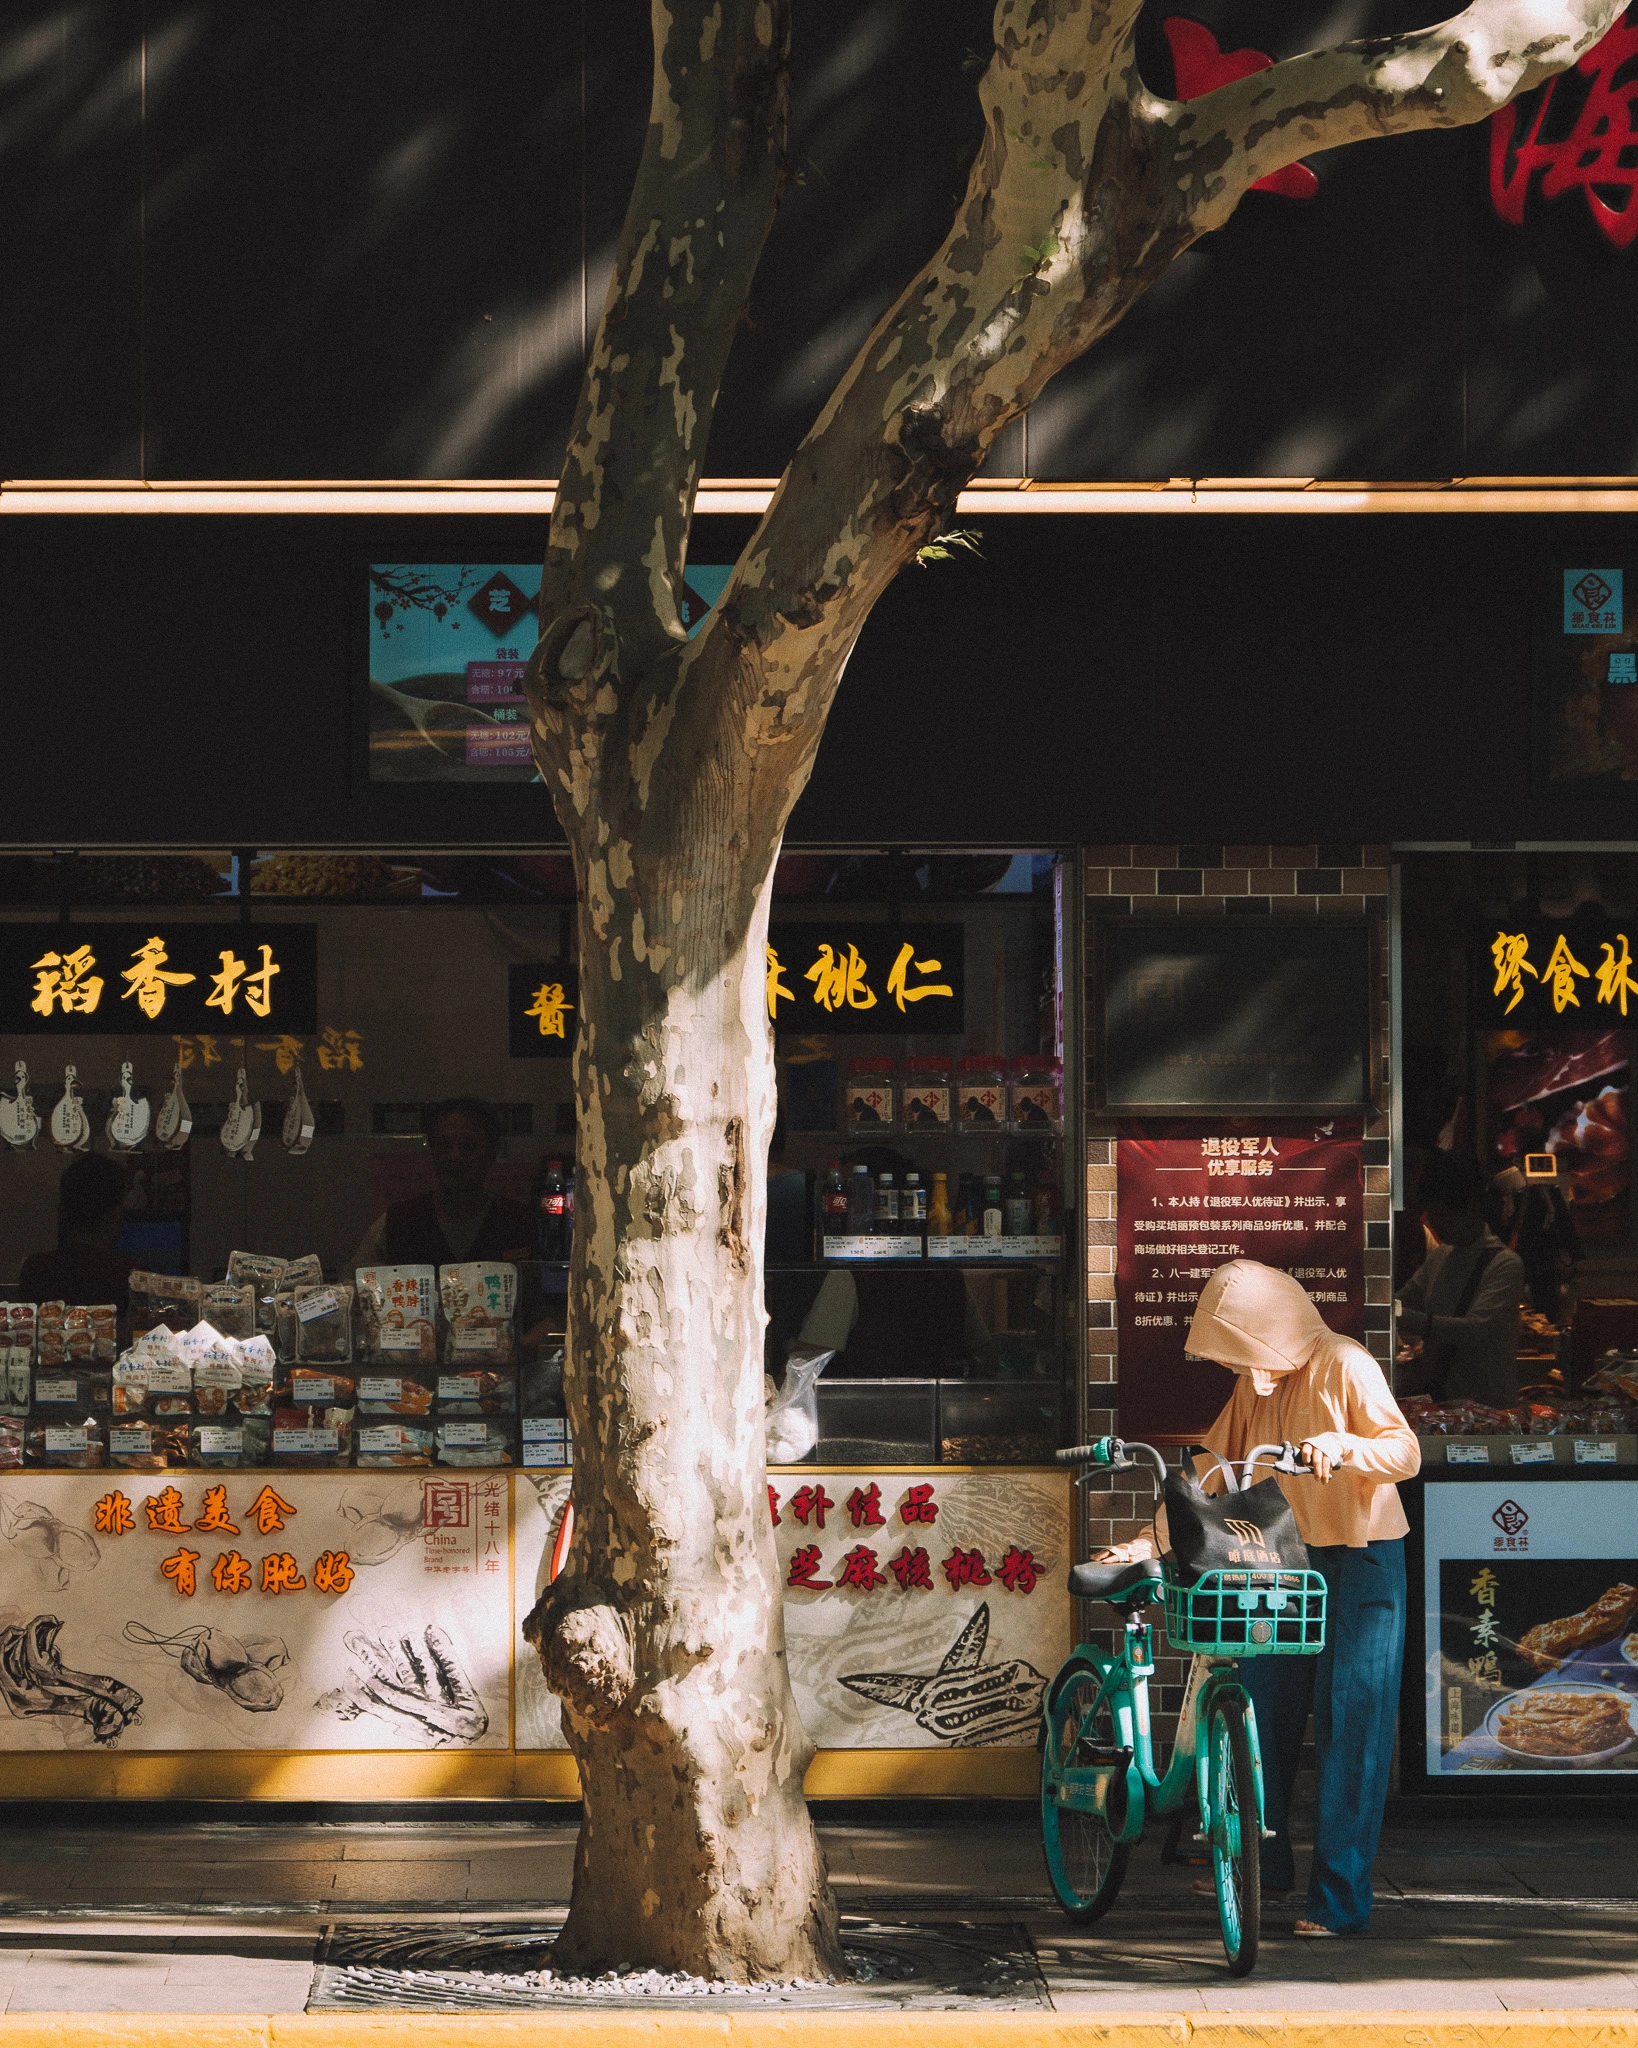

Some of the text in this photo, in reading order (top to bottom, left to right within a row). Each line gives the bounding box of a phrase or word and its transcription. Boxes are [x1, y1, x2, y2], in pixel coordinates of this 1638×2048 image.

[487, 589, 512, 613] 芝
[496, 647, 520, 660] 袋装
[493, 708, 518, 721] 桶装
[29, 937, 281, 1018] 稻香村
[1201, 1137, 1280, 1157] 退役军人
[1207, 1158, 1275, 1177] 优享服务
[1134, 1244, 1246, 1255] 商场做好相关登记工作。
[95, 1484, 297, 1535] 非遗美食
[484, 1482, 500, 1575] 光绪十八年
[424, 1534, 457, 1545] China
[425, 1547, 470, 1555] Time-honored
[161, 1547, 355, 1597] 有你肫好
[424, 1566, 470, 1574] 中华老字号
[786, 1543, 1047, 1595] 芝麻核桃粉
[1468, 1567, 1503, 1686] 香素鸭
